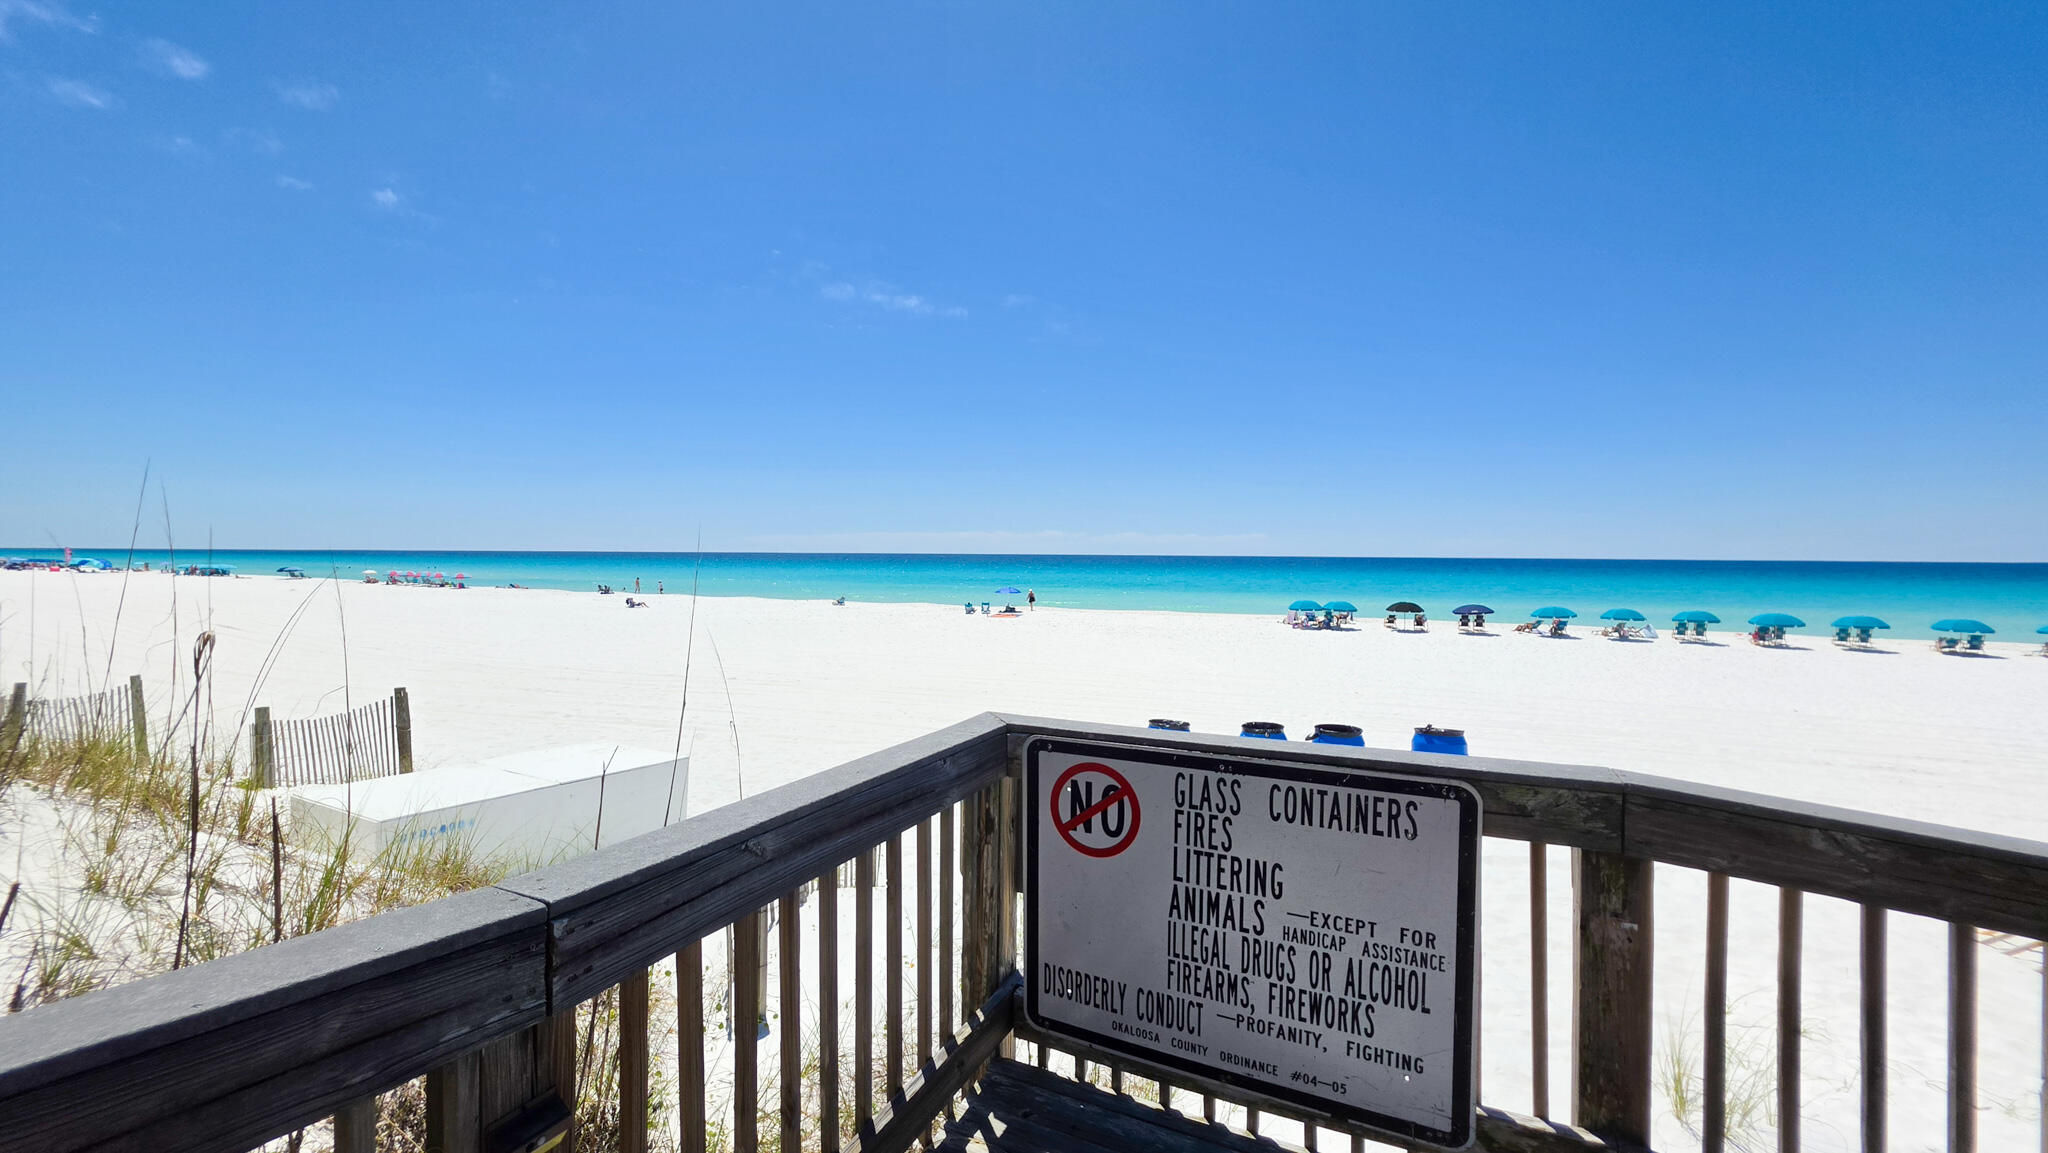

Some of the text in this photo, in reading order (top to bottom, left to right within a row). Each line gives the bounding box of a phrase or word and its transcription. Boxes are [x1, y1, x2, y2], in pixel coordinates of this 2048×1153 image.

[1070, 779, 1126, 838] NO
[1174, 772, 1420, 840] GLASS CONTAINERS
[1174, 809, 1233, 852] FIRES
[1173, 846, 1284, 900] LITTERING
[1168, 884, 1266, 936] ANIMALS
[1400, 927, 1438, 950] FOR
[1167, 920, 1431, 1015] ILLEGAL DRUGS OR ALCOHOL
[1282, 925, 1447, 972] HANDICAP ASSISTANCE
[1044, 962, 1127, 1016] DISORDERLY
[1136, 987, 1204, 1037] CONDUCT
[1346, 1040, 1425, 1074] FIGHTING
[1167, 959, 1376, 1039] FIREARMS, FIREWORKS
[1111, 1020, 1160, 1044] OKALOOSA
[1171, 1036, 1208, 1057] COUNTY
[1220, 1050, 1279, 1077] ORDINANCE
